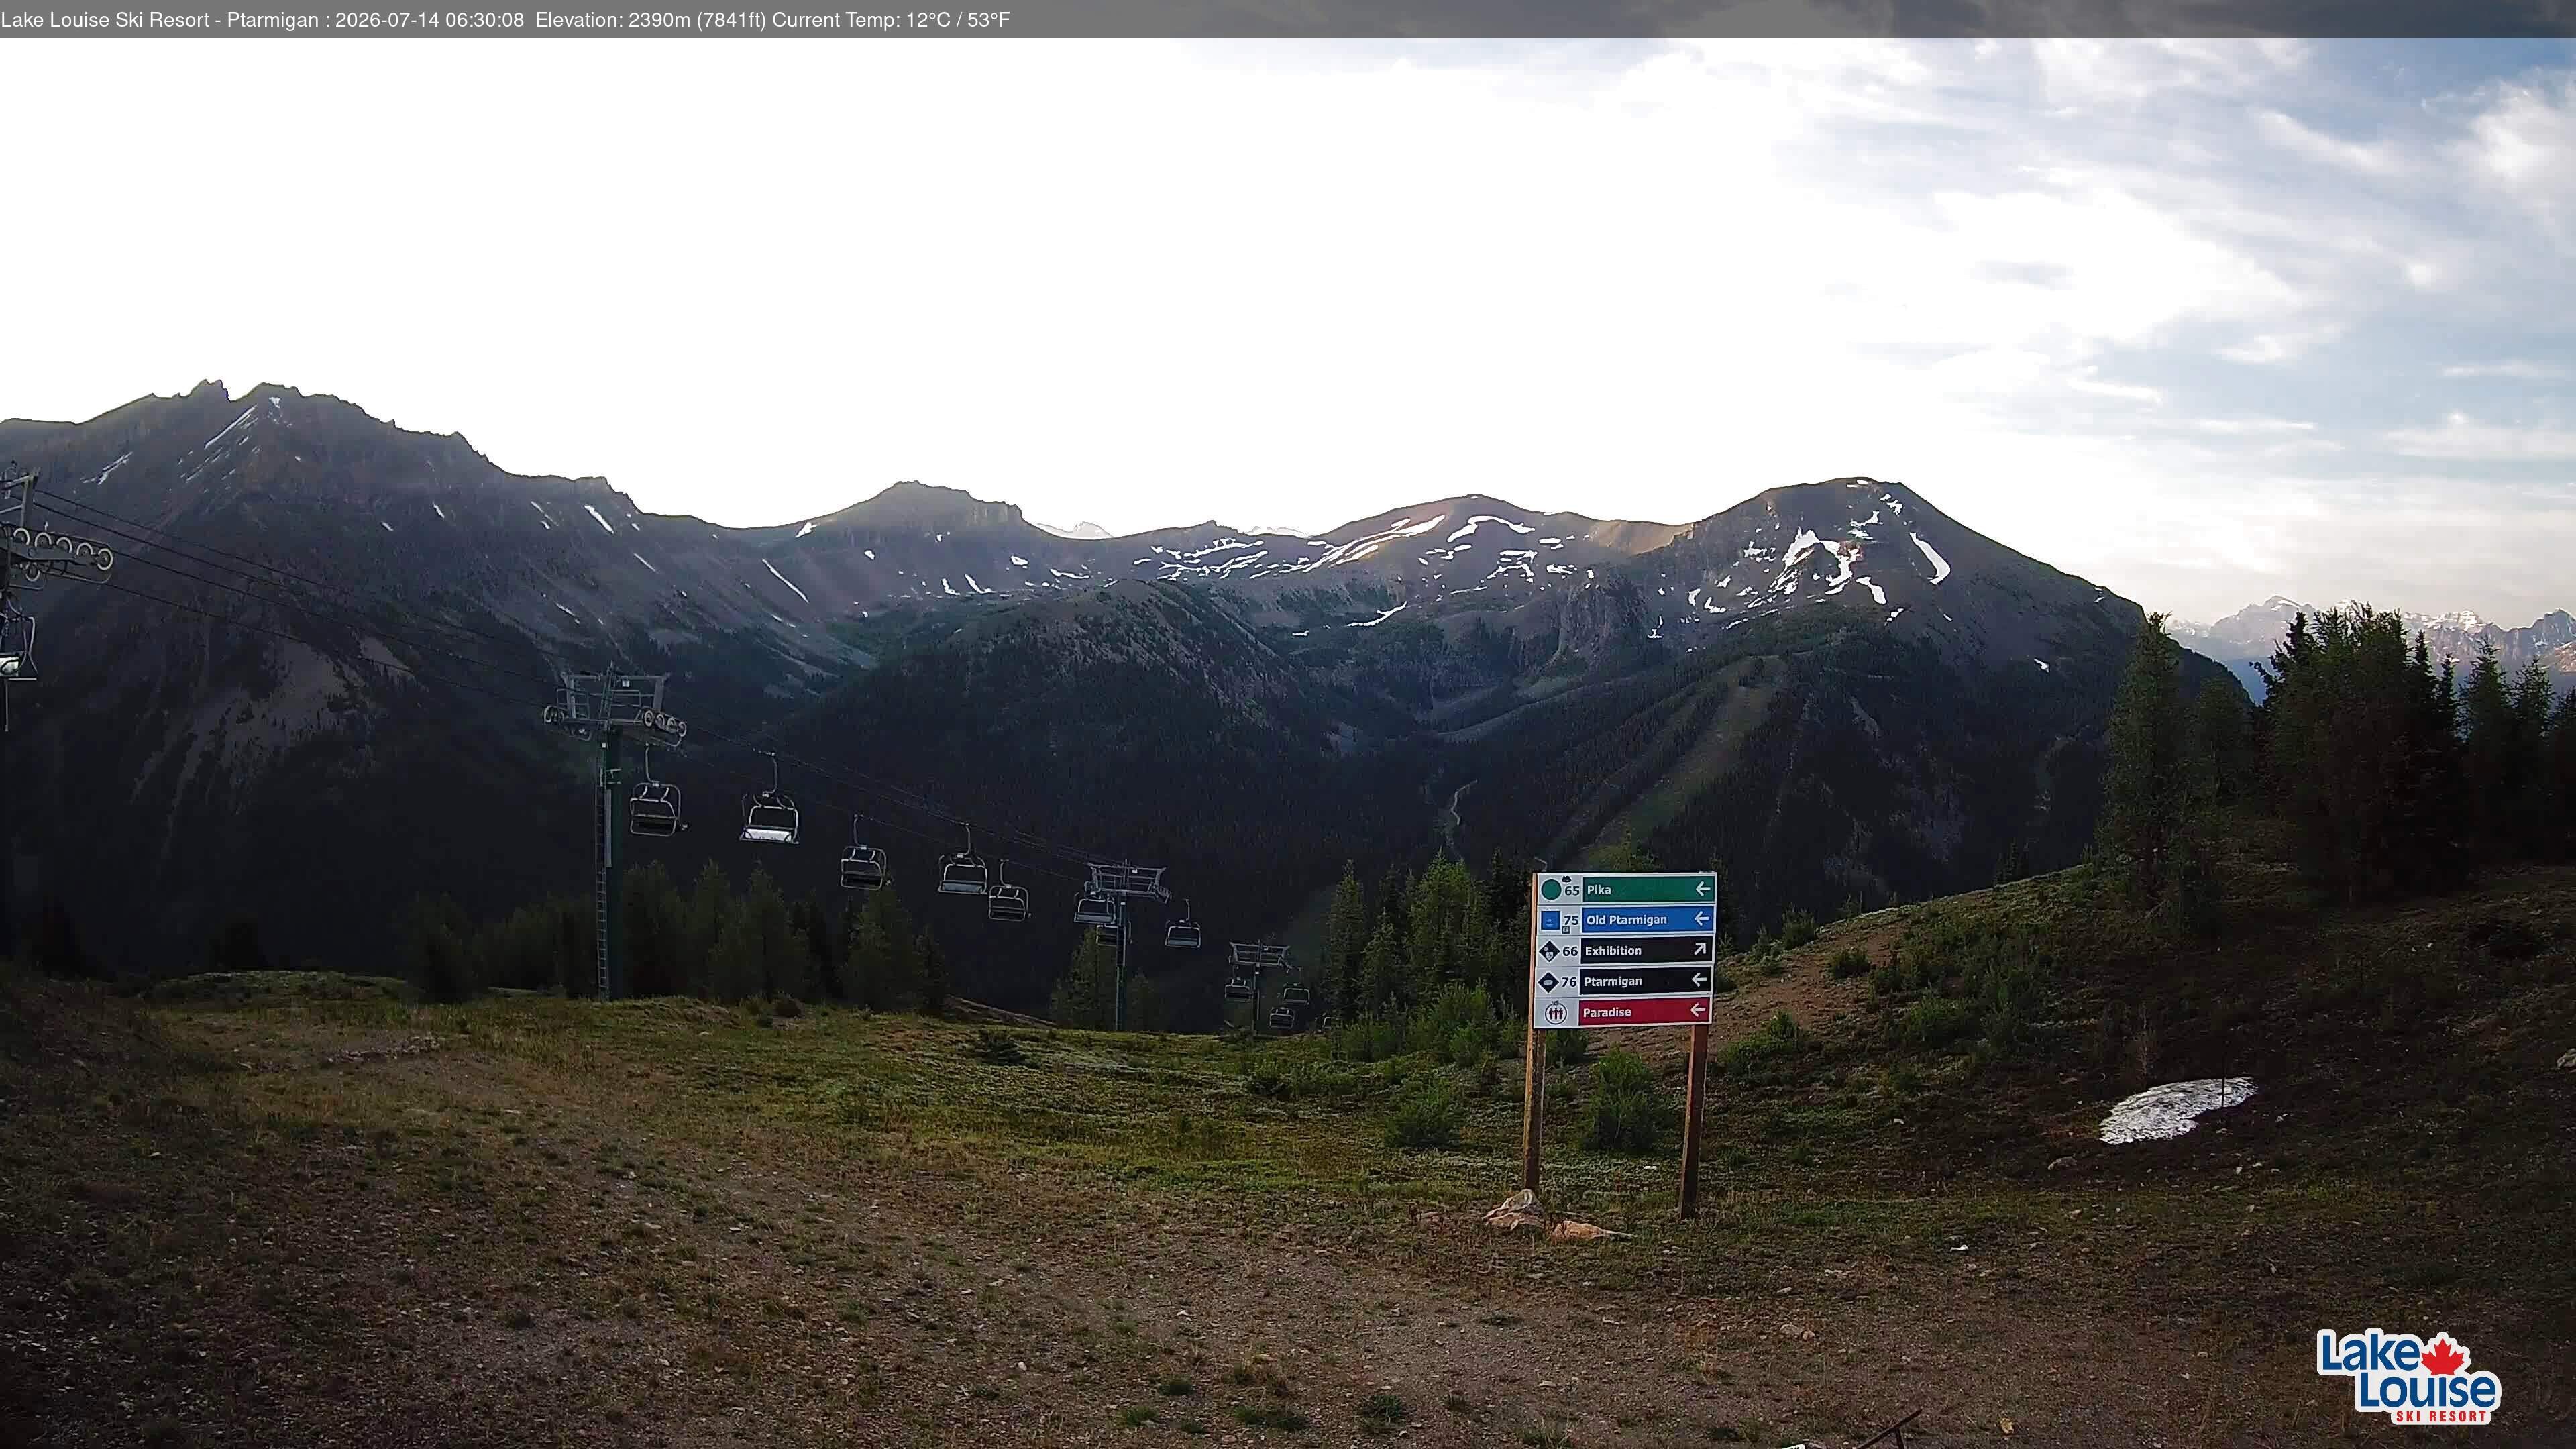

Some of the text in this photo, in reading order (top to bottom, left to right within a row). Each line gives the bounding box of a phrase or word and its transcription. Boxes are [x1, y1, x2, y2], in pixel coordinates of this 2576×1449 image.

[1564, 884, 1611, 896] 65 Pika
[1564, 914, 1668, 926] 75 Old Ptarmigan
[1562, 945, 1642, 957] 66 Exhibition
[1561, 976, 1643, 989] 76 Ptarmigan
[1583, 1007, 1632, 1018] Paradise
